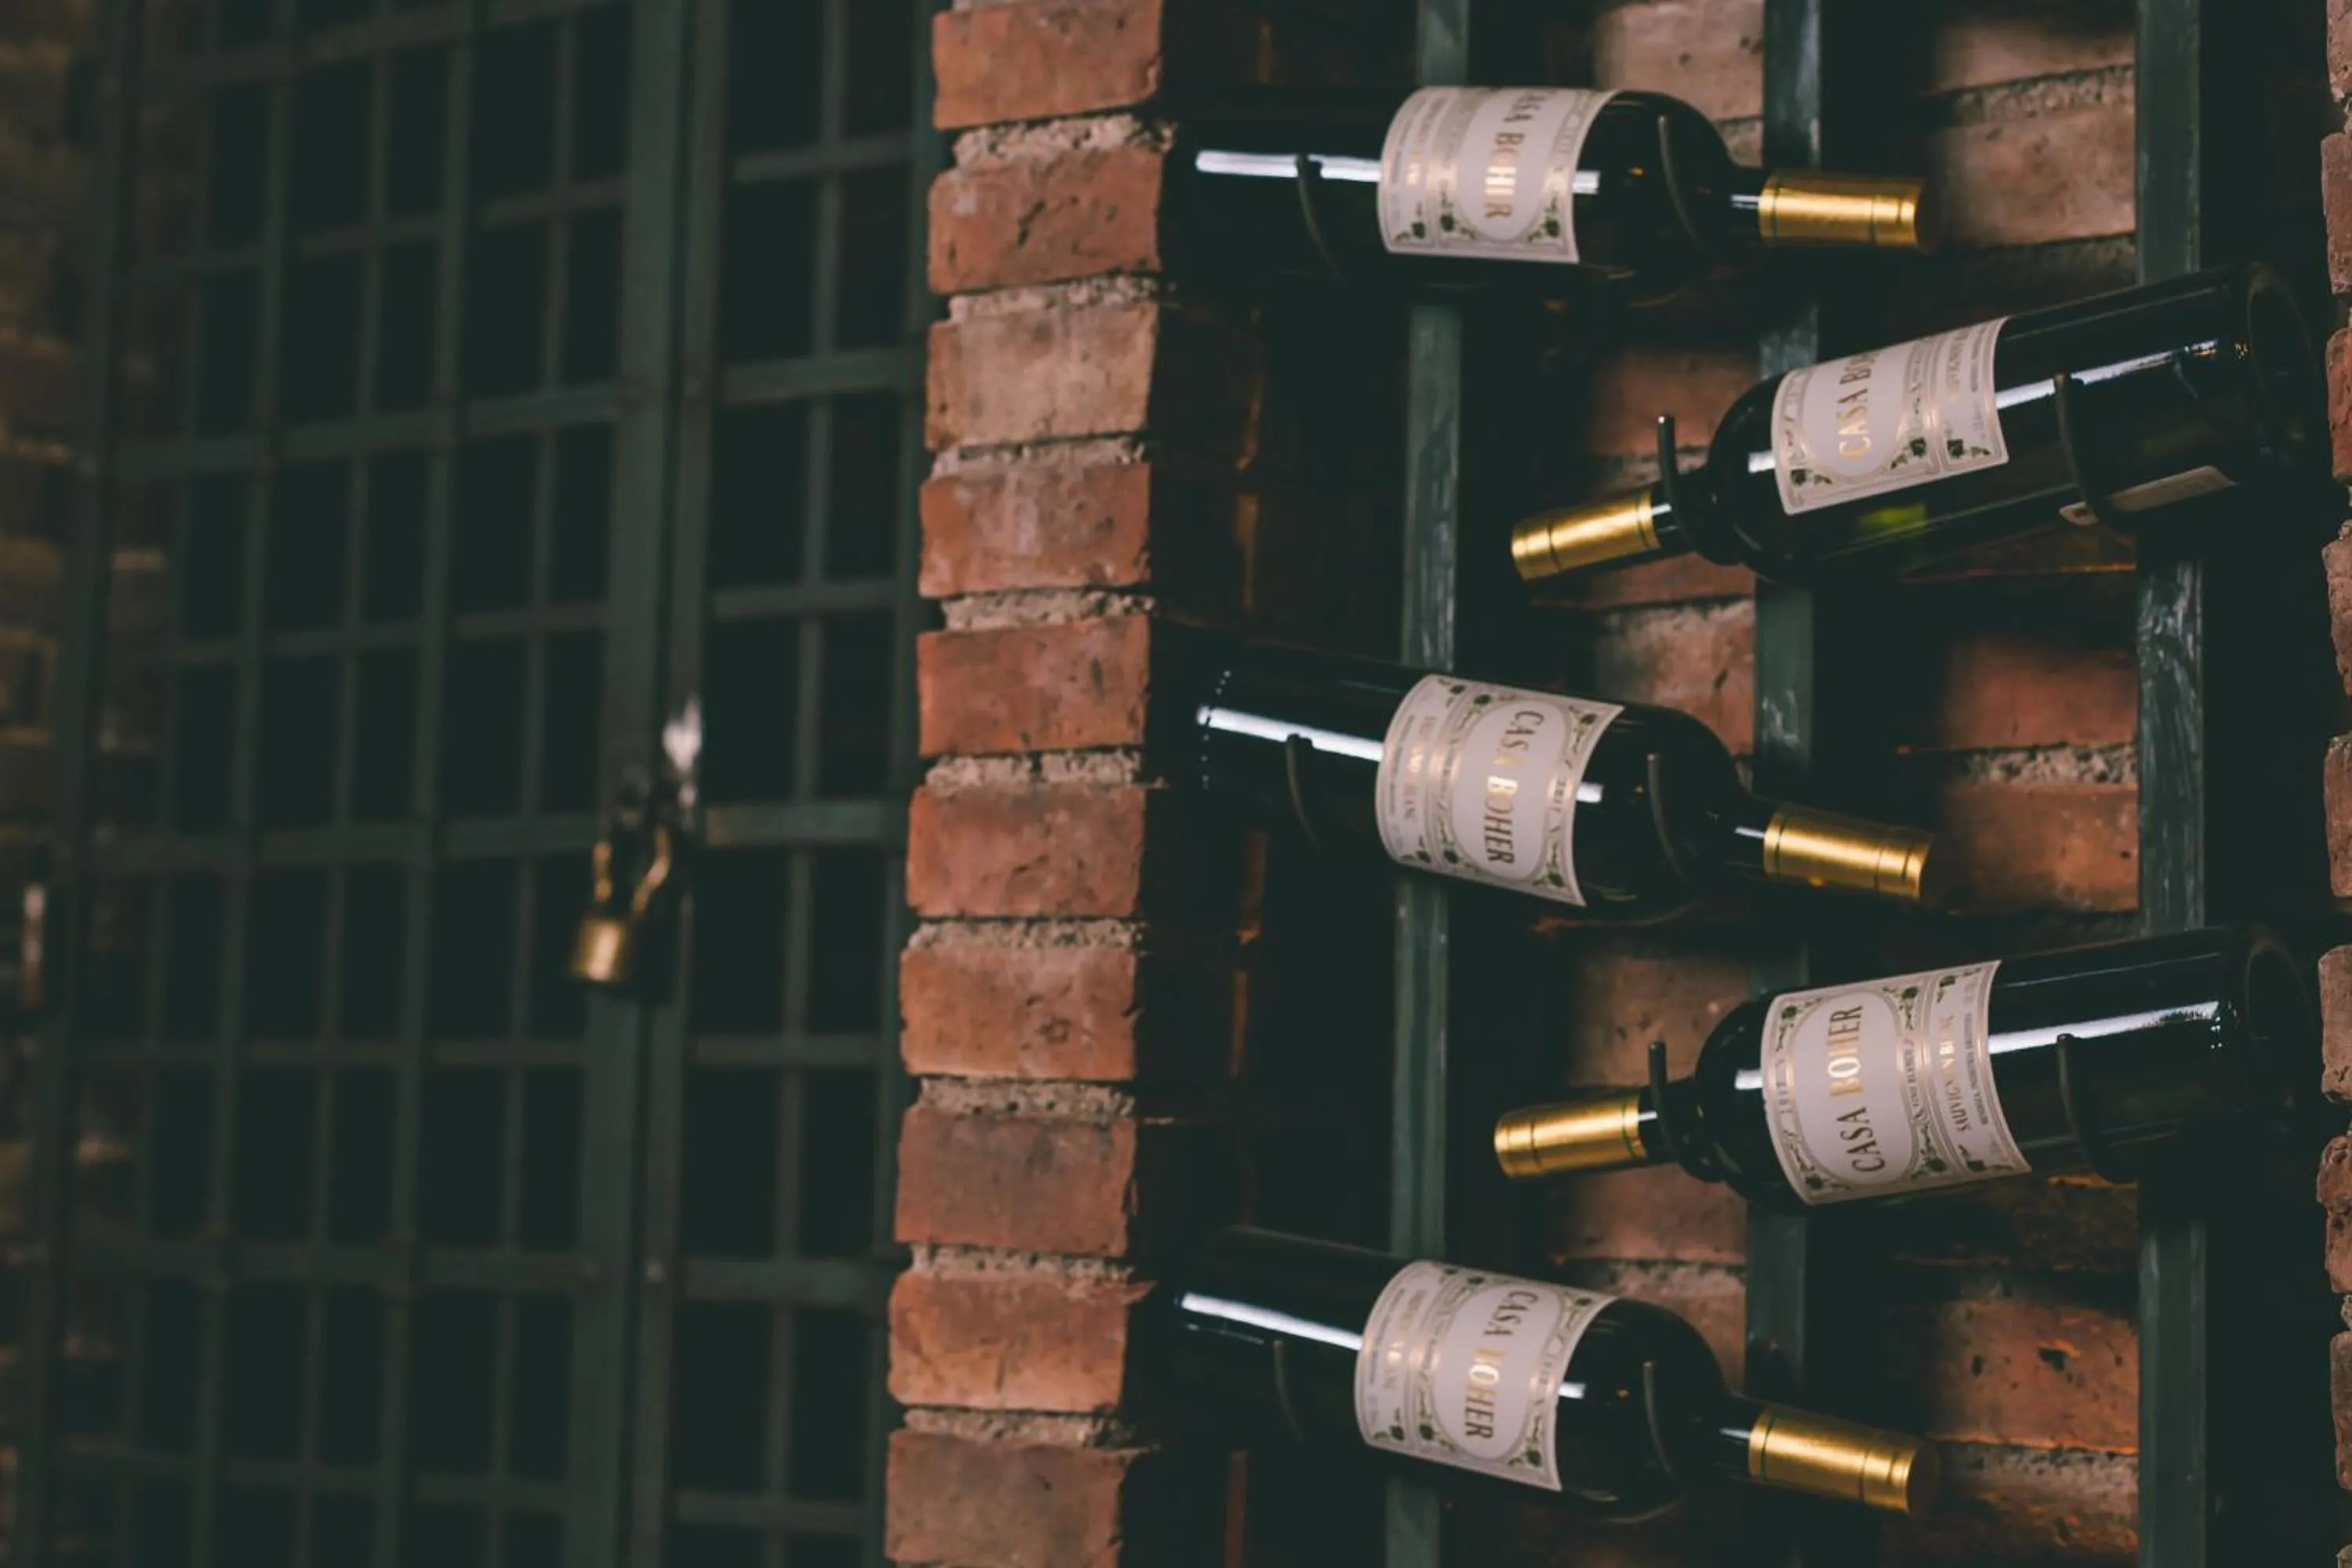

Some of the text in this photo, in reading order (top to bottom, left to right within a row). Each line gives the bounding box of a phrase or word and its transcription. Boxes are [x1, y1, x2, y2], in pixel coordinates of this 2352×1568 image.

[1838, 388, 1871, 459] CASA
[1483, 710, 1544, 864] CASA BOHER
[1827, 1005, 1886, 1173] CASA BOHER
[1465, 1290, 1539, 1439] CASA BOHER
